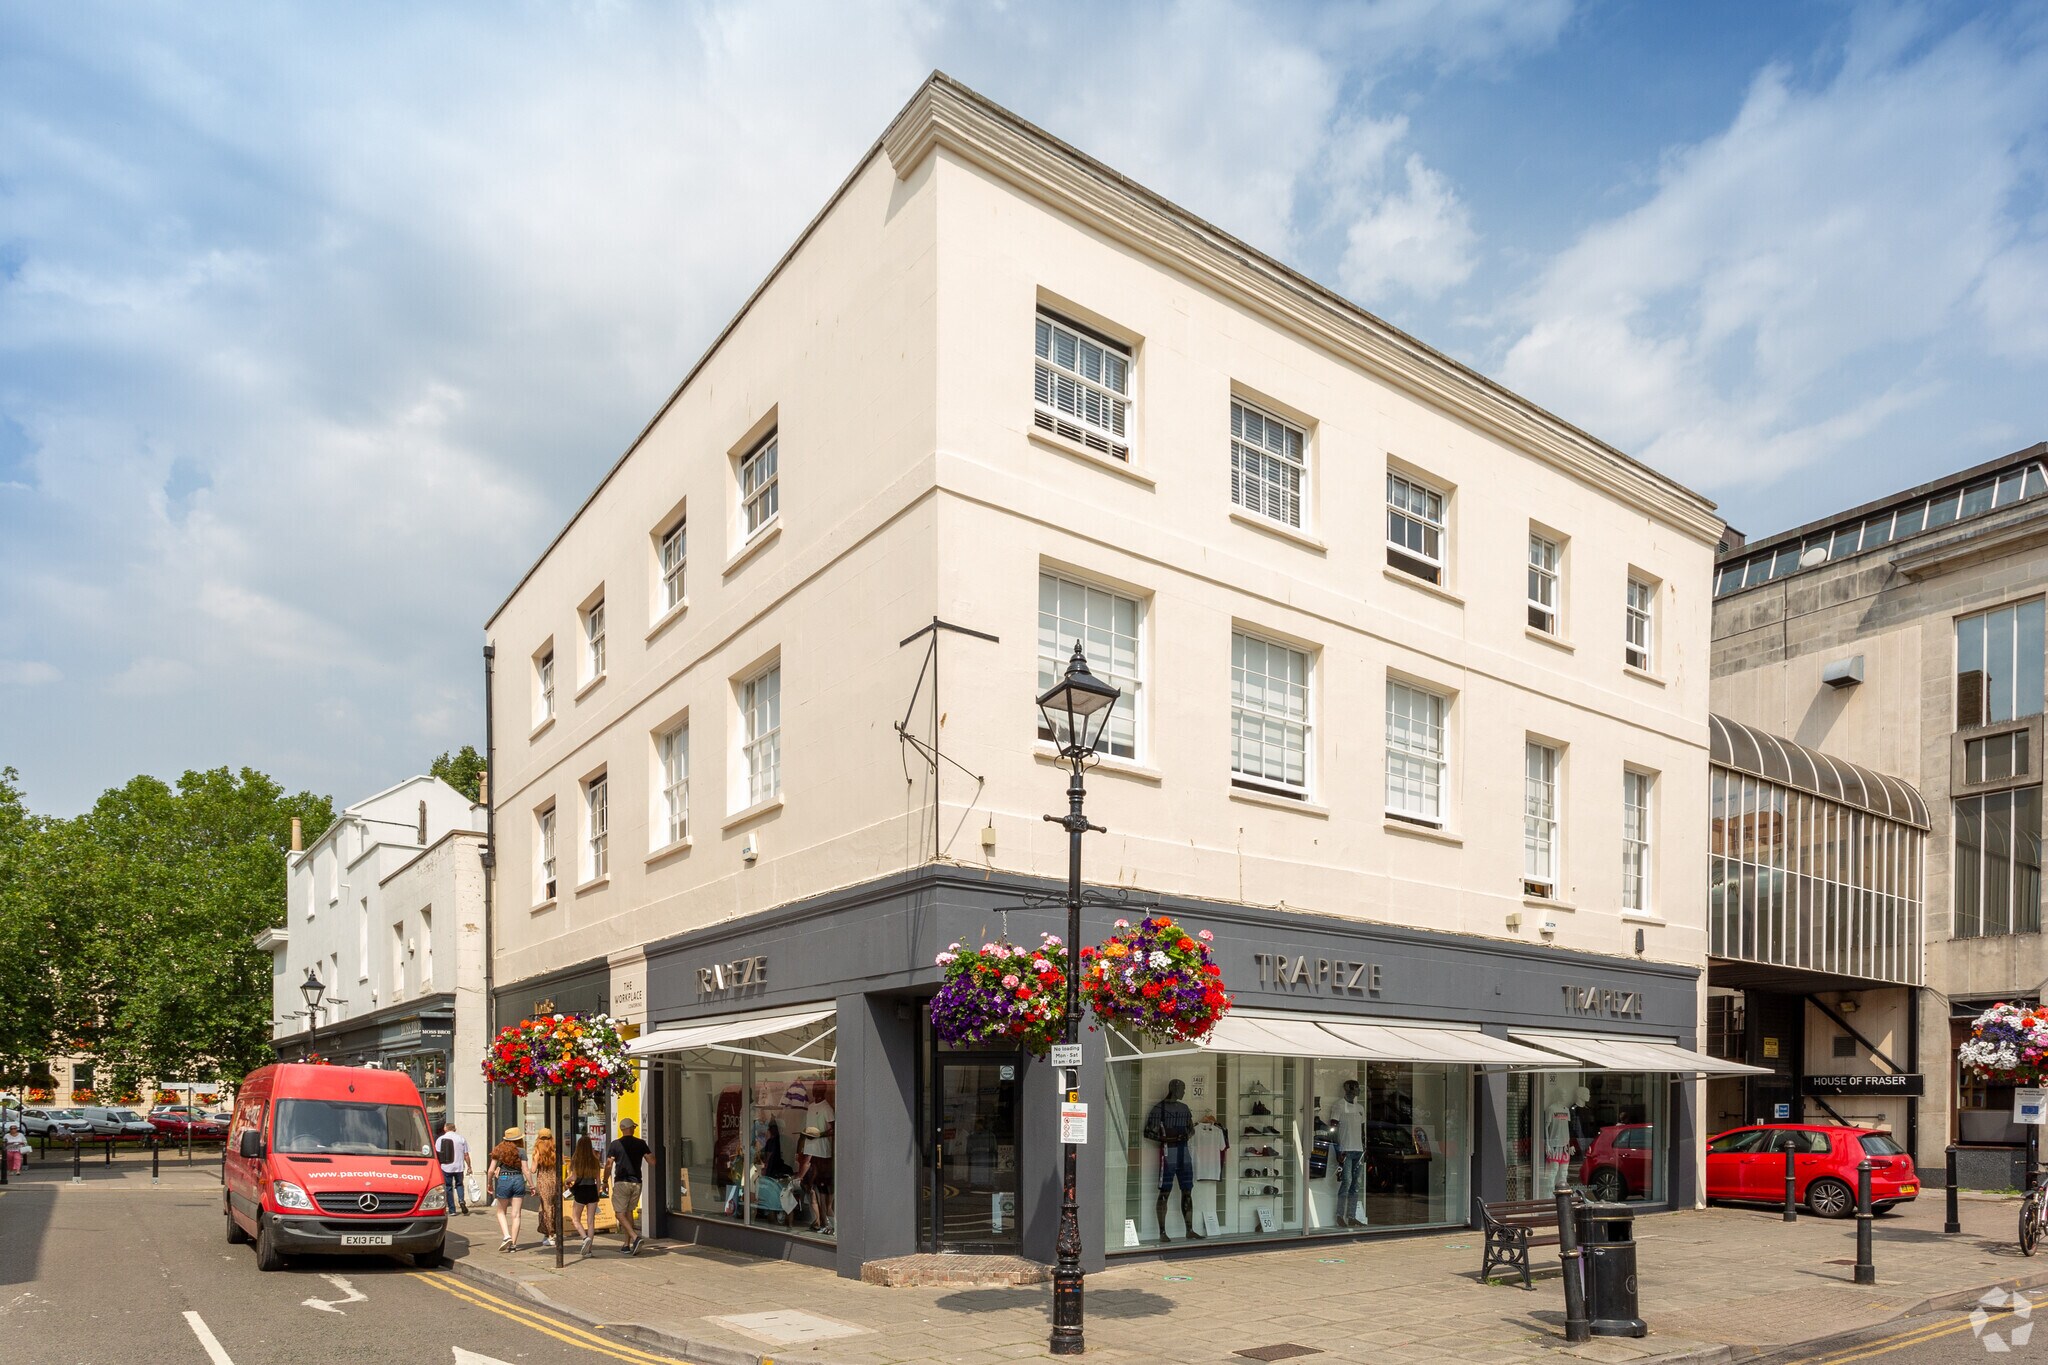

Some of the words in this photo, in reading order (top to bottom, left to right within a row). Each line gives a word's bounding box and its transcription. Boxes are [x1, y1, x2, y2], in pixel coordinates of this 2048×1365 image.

[1255, 953, 1383, 990] TRAPEZE
[623, 981, 633, 991] THE
[614, 990, 642, 1004] WORKPLACE
[1561, 985, 1644, 1014] TRAPEZE
[1813, 1076, 1847, 1086] HOUSE
[1849, 1076, 1863, 1086] OF
[1865, 1076, 1906, 1085] FRASER
[308, 1169, 424, 1181] www.parcelforce.com
[346, 1237, 367, 1245] EX13
[368, 1236, 387, 1245] FCL
